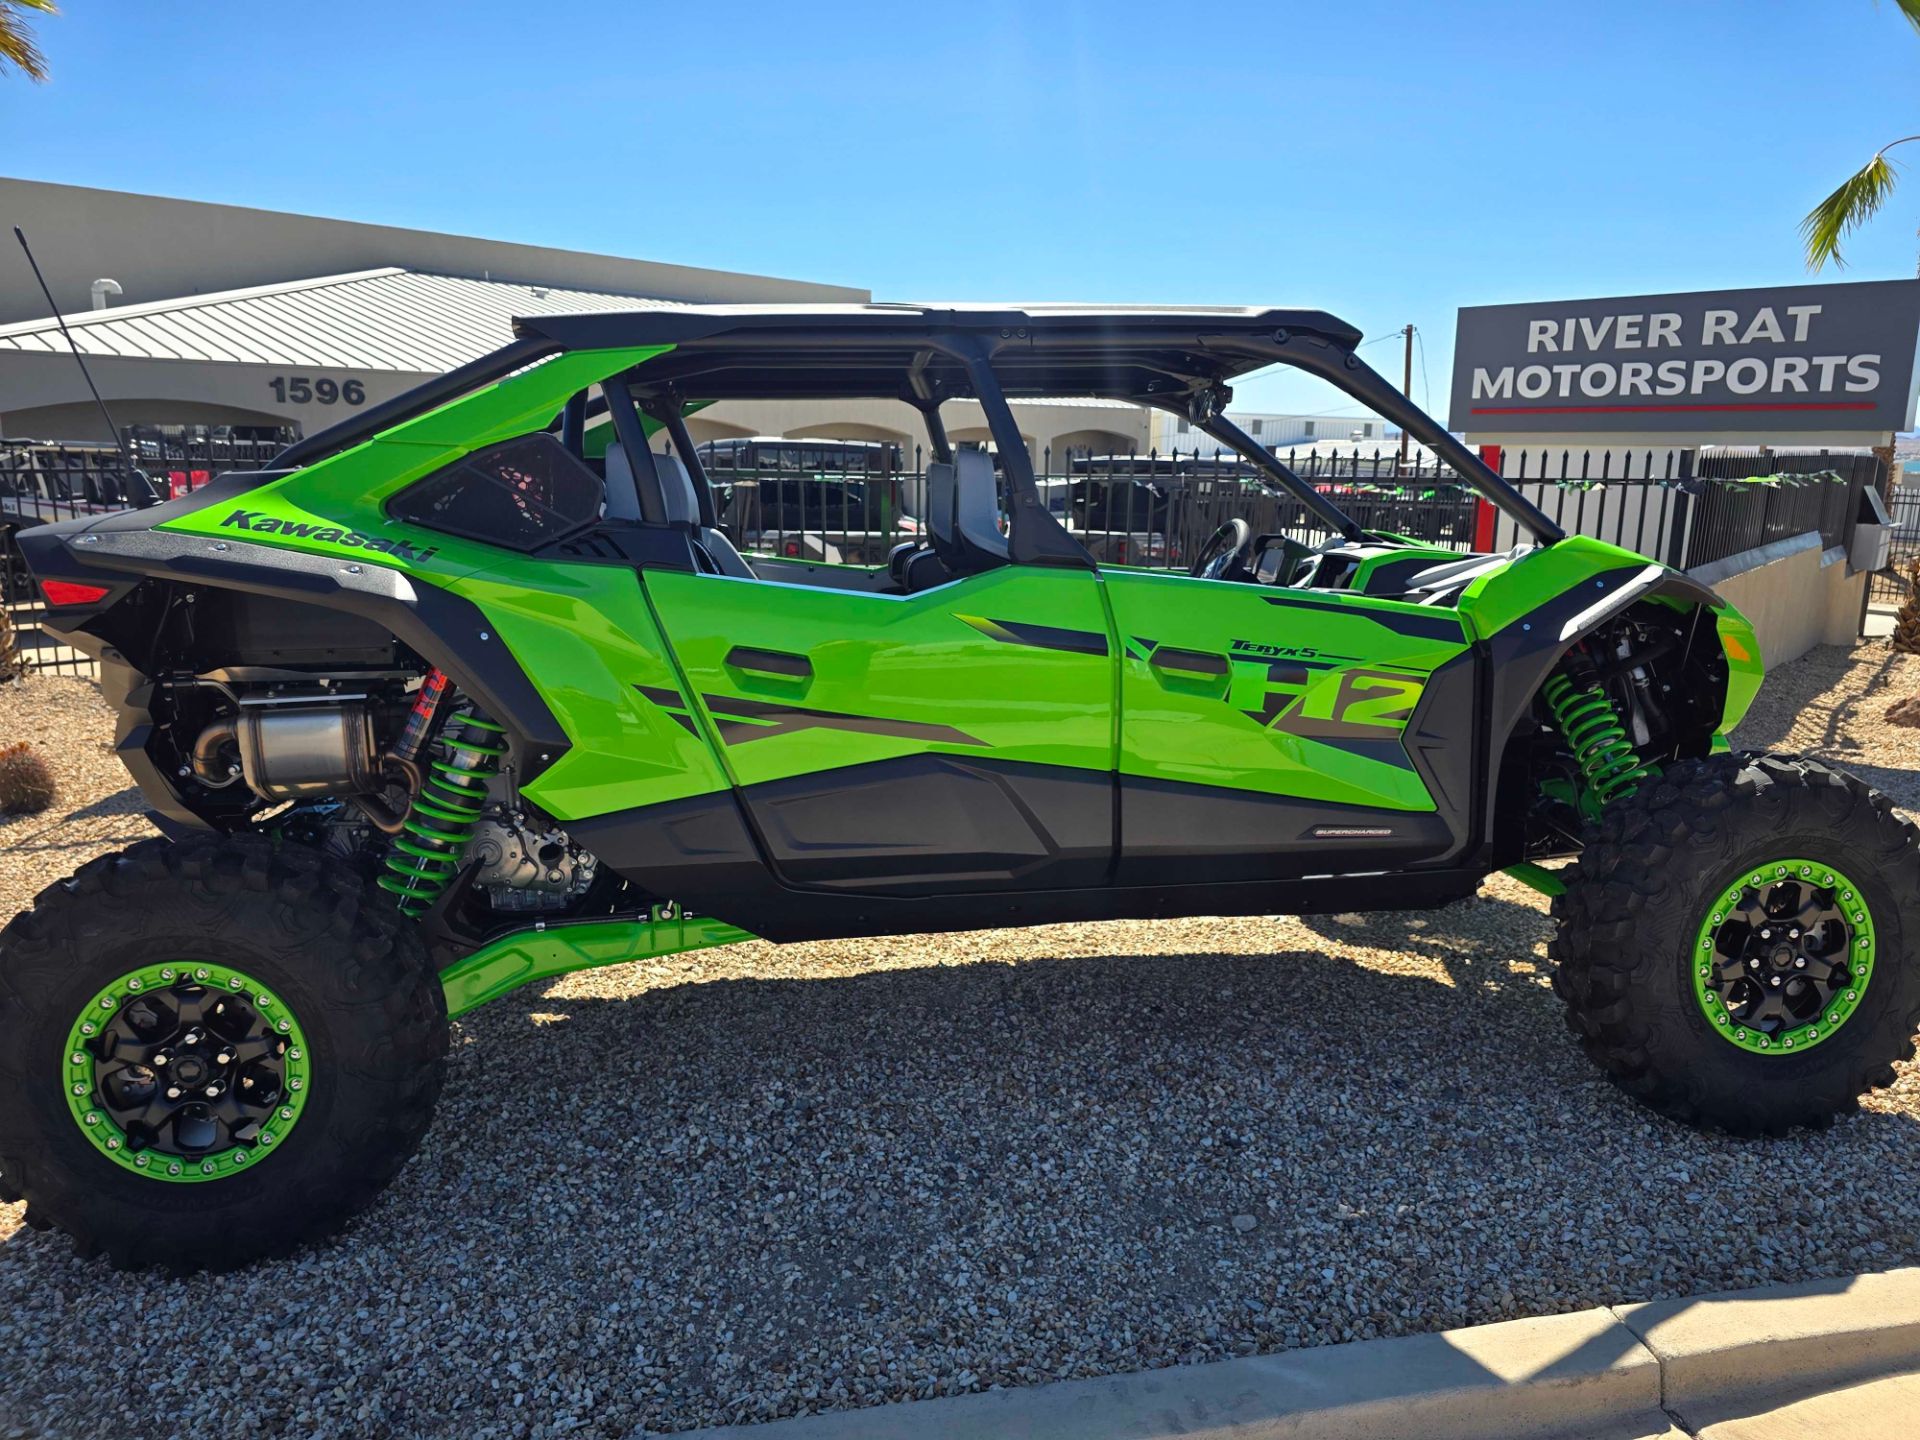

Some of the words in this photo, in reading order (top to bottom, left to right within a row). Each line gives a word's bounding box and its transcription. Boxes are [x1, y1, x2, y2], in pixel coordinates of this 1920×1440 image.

[1527, 312, 1683, 354] RIVER
[1701, 304, 1823, 346] RAT
[268, 376, 366, 405] 1596
[1471, 353, 1882, 399] MOTORSPORTS
[219, 509, 440, 564] Kawasaki
[1228, 660, 1424, 729] H2
